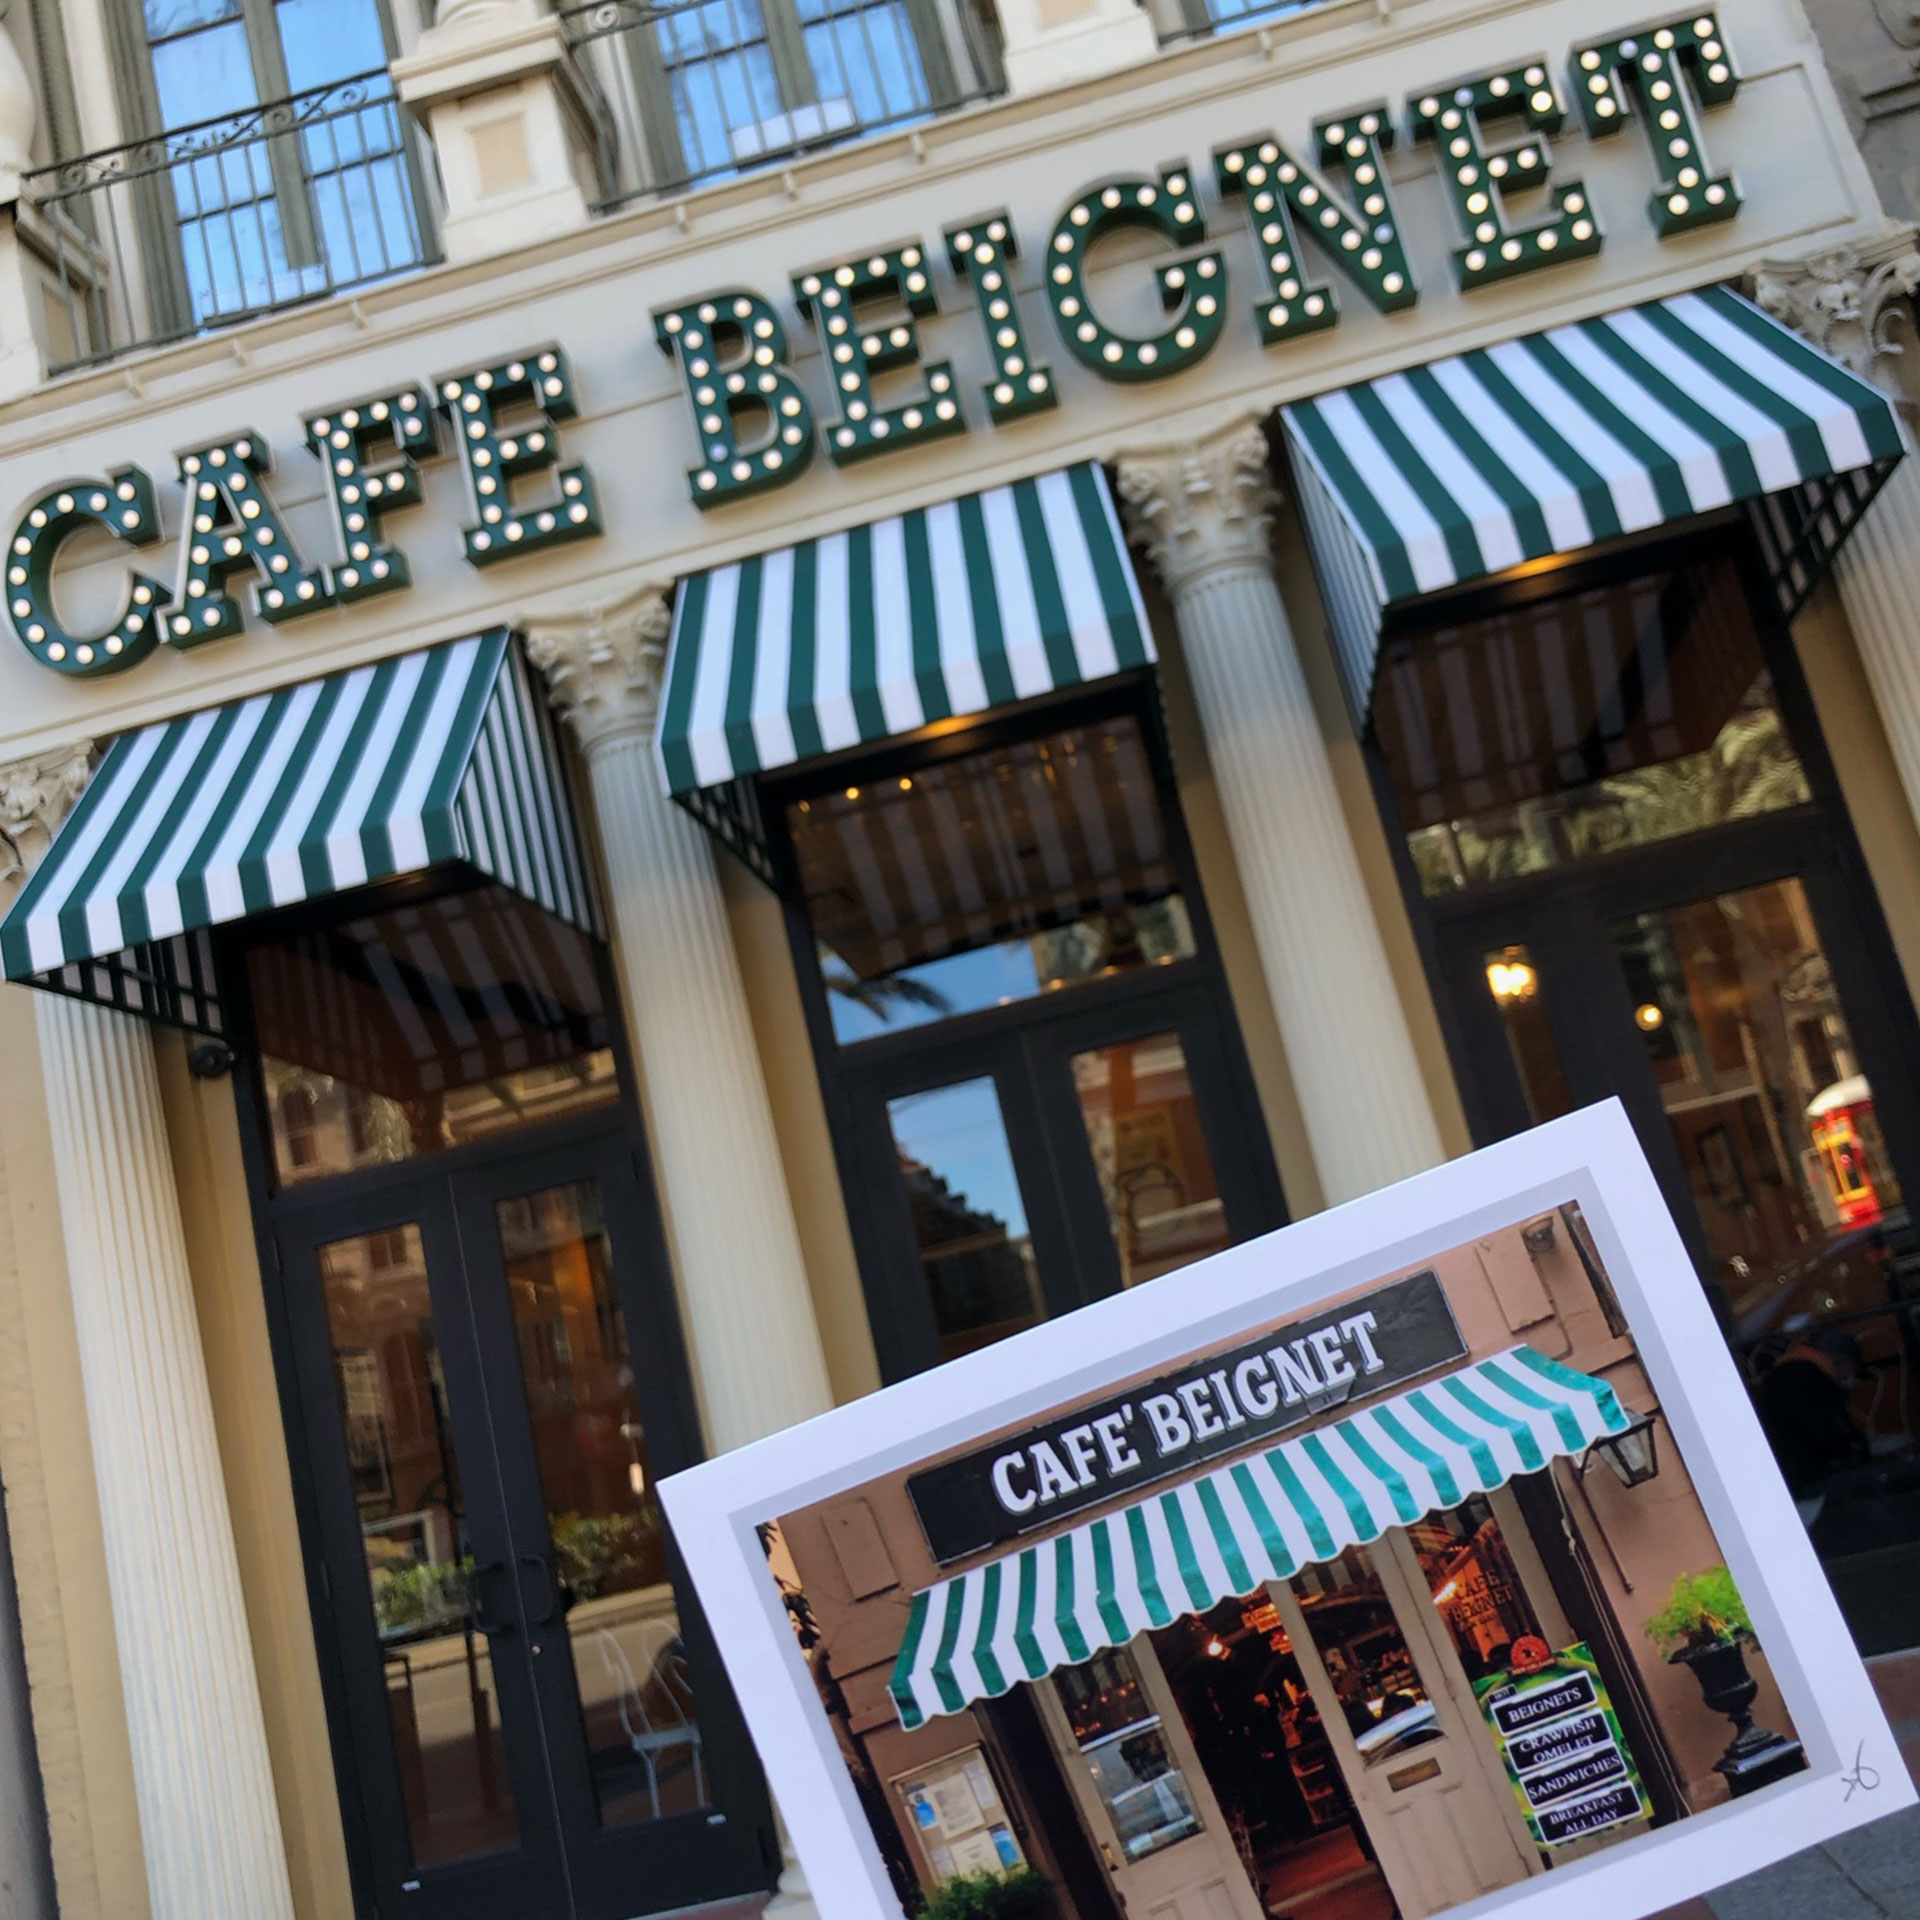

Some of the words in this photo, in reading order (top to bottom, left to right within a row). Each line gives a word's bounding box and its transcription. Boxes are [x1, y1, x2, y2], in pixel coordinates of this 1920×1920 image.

[5, 341, 604, 677] CAFE
[647, 11, 1741, 509] BEIGNET
[1142, 1309, 1386, 1459] BEIGNET
[1507, 1686, 1583, 1724] BEIGNETS
[1519, 1718, 1597, 1753] CRAWFISH
[1533, 1735, 1595, 1764] OMELET
[1528, 1755, 1621, 1799] SANDWICHES
[1549, 1791, 1624, 1825] BREAKFAST
[1565, 1817, 1590, 1835] ALL
[1591, 1809, 1619, 1827] DAY
